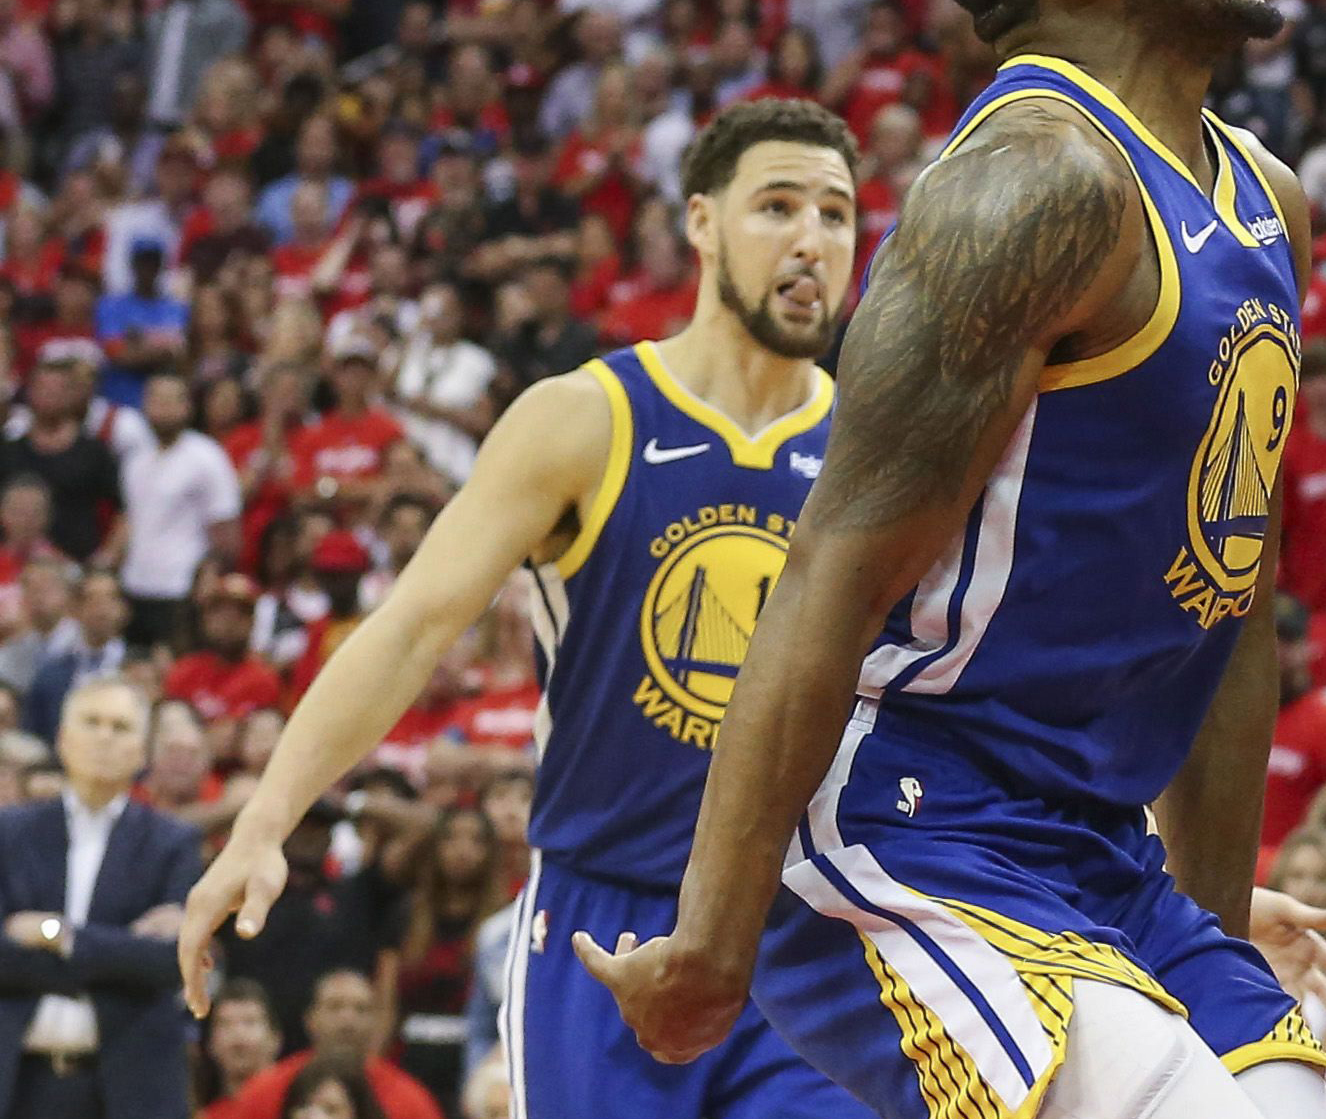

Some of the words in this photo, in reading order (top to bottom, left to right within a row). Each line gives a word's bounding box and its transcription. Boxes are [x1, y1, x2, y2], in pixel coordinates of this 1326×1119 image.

[1208, 298, 1268, 386] GOLDEN
[1266, 385, 1287, 452] 9
[650, 503, 756, 559] GOLDEN
